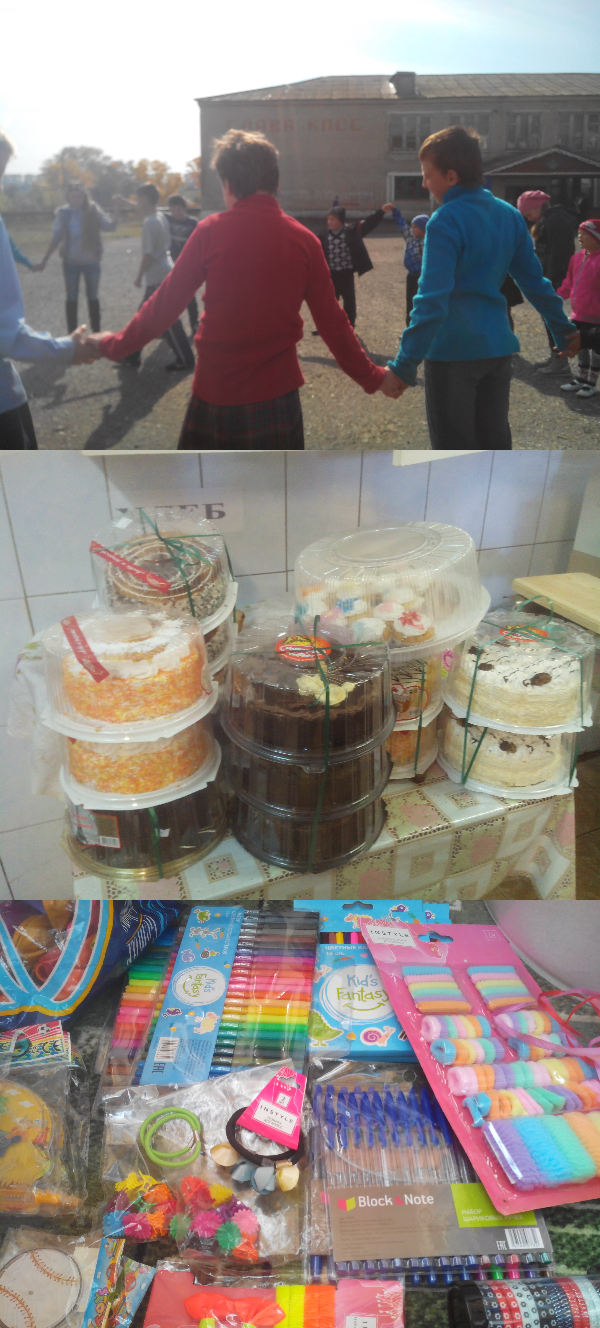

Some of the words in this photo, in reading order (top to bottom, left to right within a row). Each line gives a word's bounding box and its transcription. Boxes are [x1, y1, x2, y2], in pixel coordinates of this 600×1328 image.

[308, 118, 363, 132] КПСС
[346, 974, 379, 988] Kid's
[259, 1105, 294, 1124] INSTYLE
[358, 1195, 393, 1207] Block
[404, 1194, 434, 1206] Note
